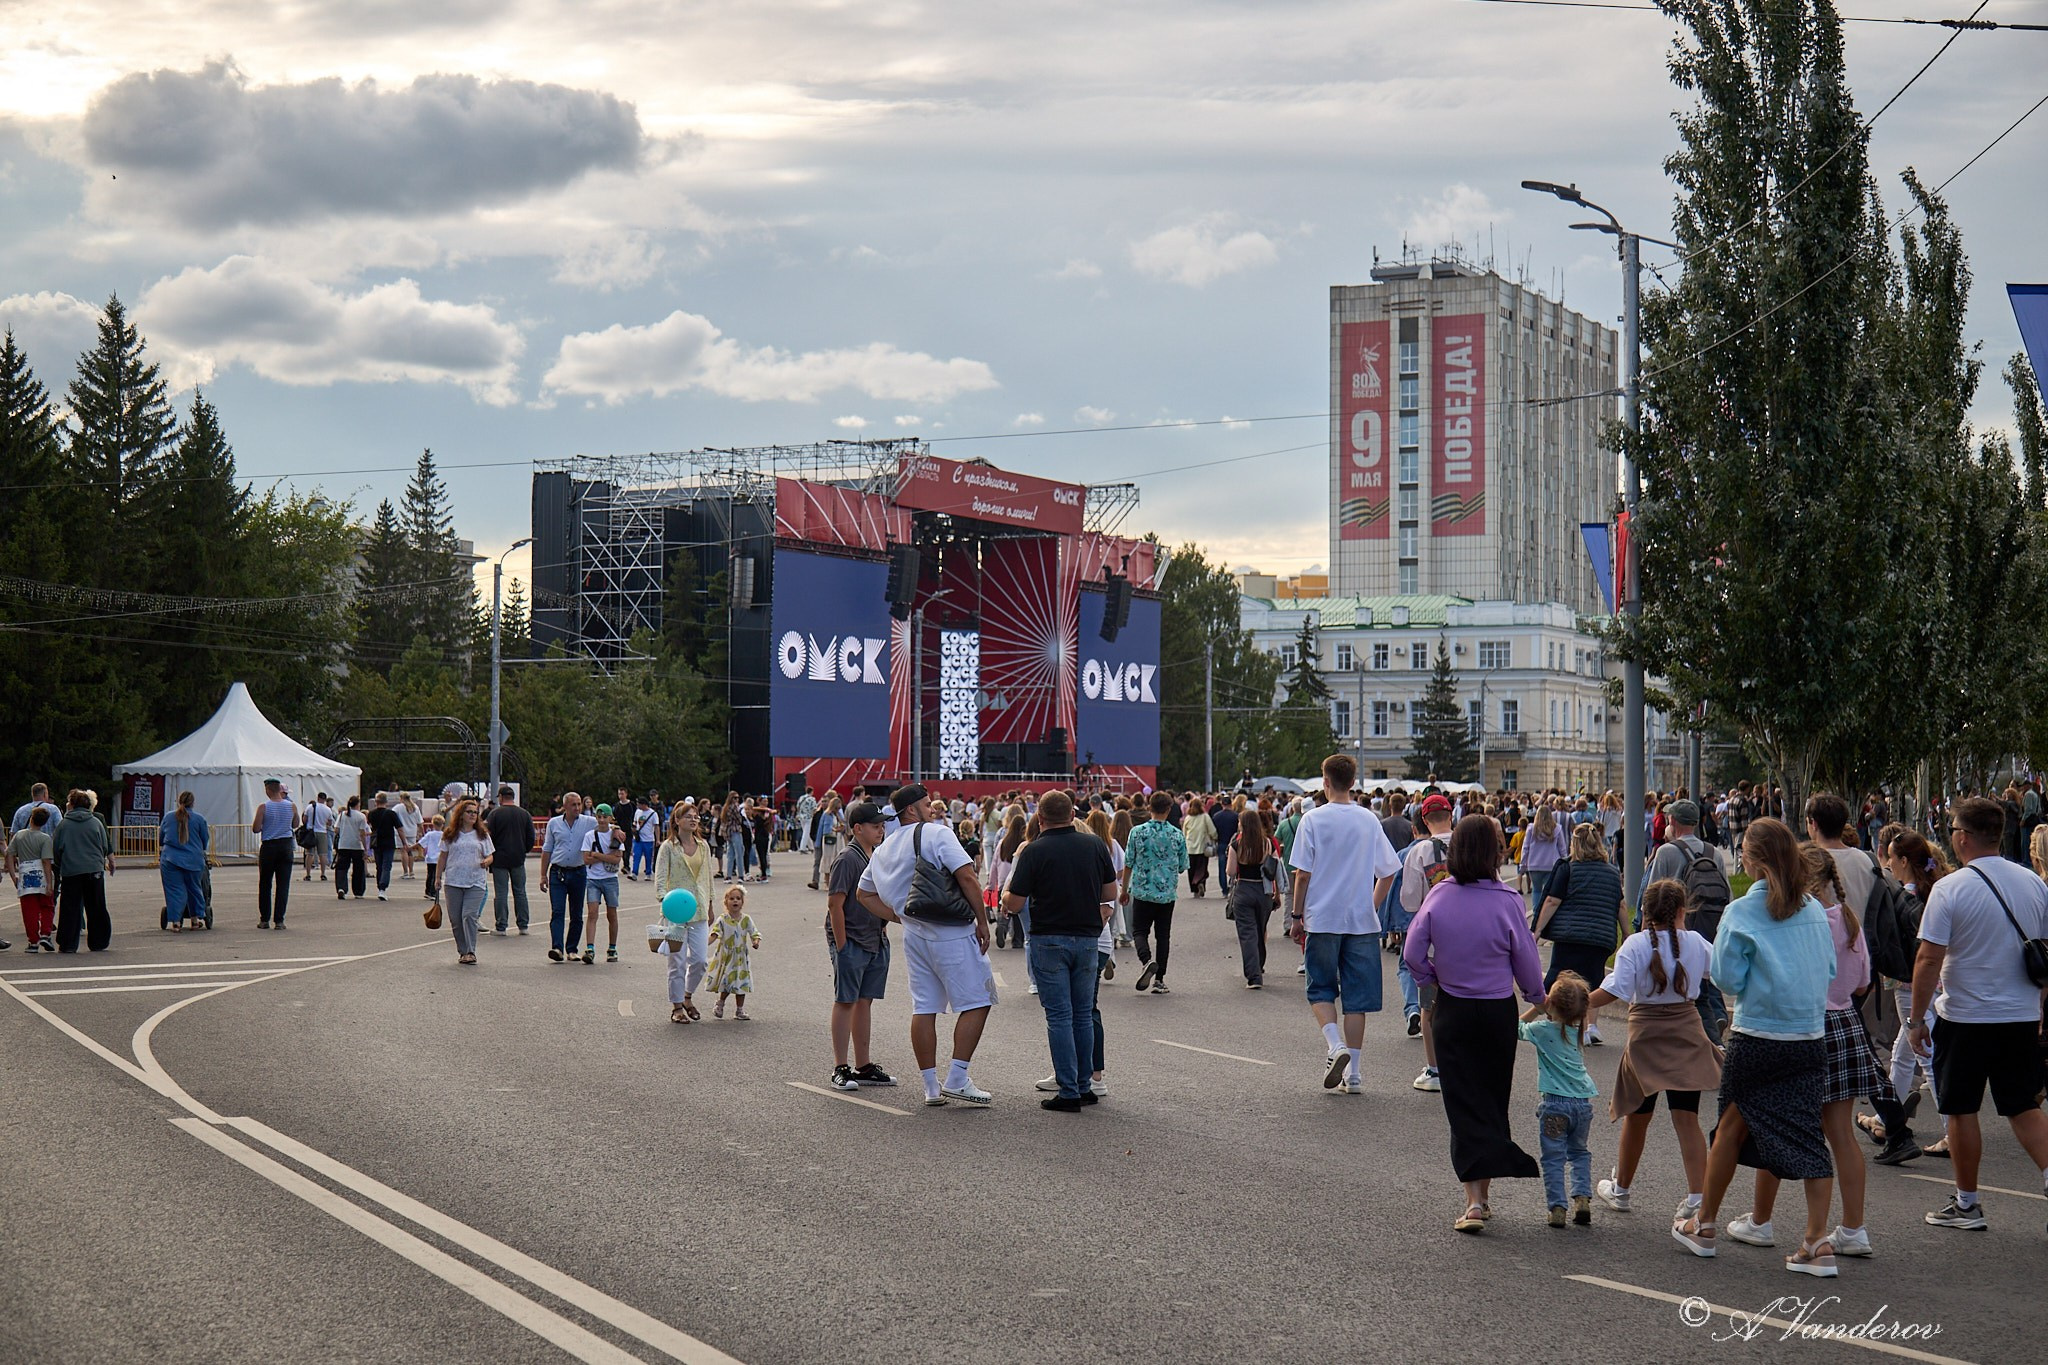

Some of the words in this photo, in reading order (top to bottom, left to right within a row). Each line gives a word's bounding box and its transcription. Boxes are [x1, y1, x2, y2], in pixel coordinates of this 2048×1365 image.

[1352, 373, 1371, 388] 80
[1352, 388, 1382, 399] ПОБЕДА!
[1444, 334, 1477, 483] ПОБЕДА!
[1351, 410, 1382, 468] 9
[952, 464, 963, 484] С
[964, 472, 1019, 493] праздником,
[1351, 472, 1382, 488] МАЯ
[1053, 488, 1080, 506] ОМСК
[972, 495, 1005, 517] дорогие
[941, 633, 979, 644] КОМС
[941, 644, 979, 655] СКОМ
[777, 630, 887, 685] ОМСК
[941, 656, 979, 667] МСКО
[941, 666, 979, 678] ОМСК
[941, 678, 979, 689] КОМС
[1081, 658, 1157, 704] ОМСК
[941, 689, 979, 700] СКОМ
[941, 700, 978, 712] МСКО
[941, 712, 978, 723] ОМСК
[940, 723, 978, 734] КОМС
[940, 734, 978, 745] СКОМ
[940, 745, 978, 757] МСКО
